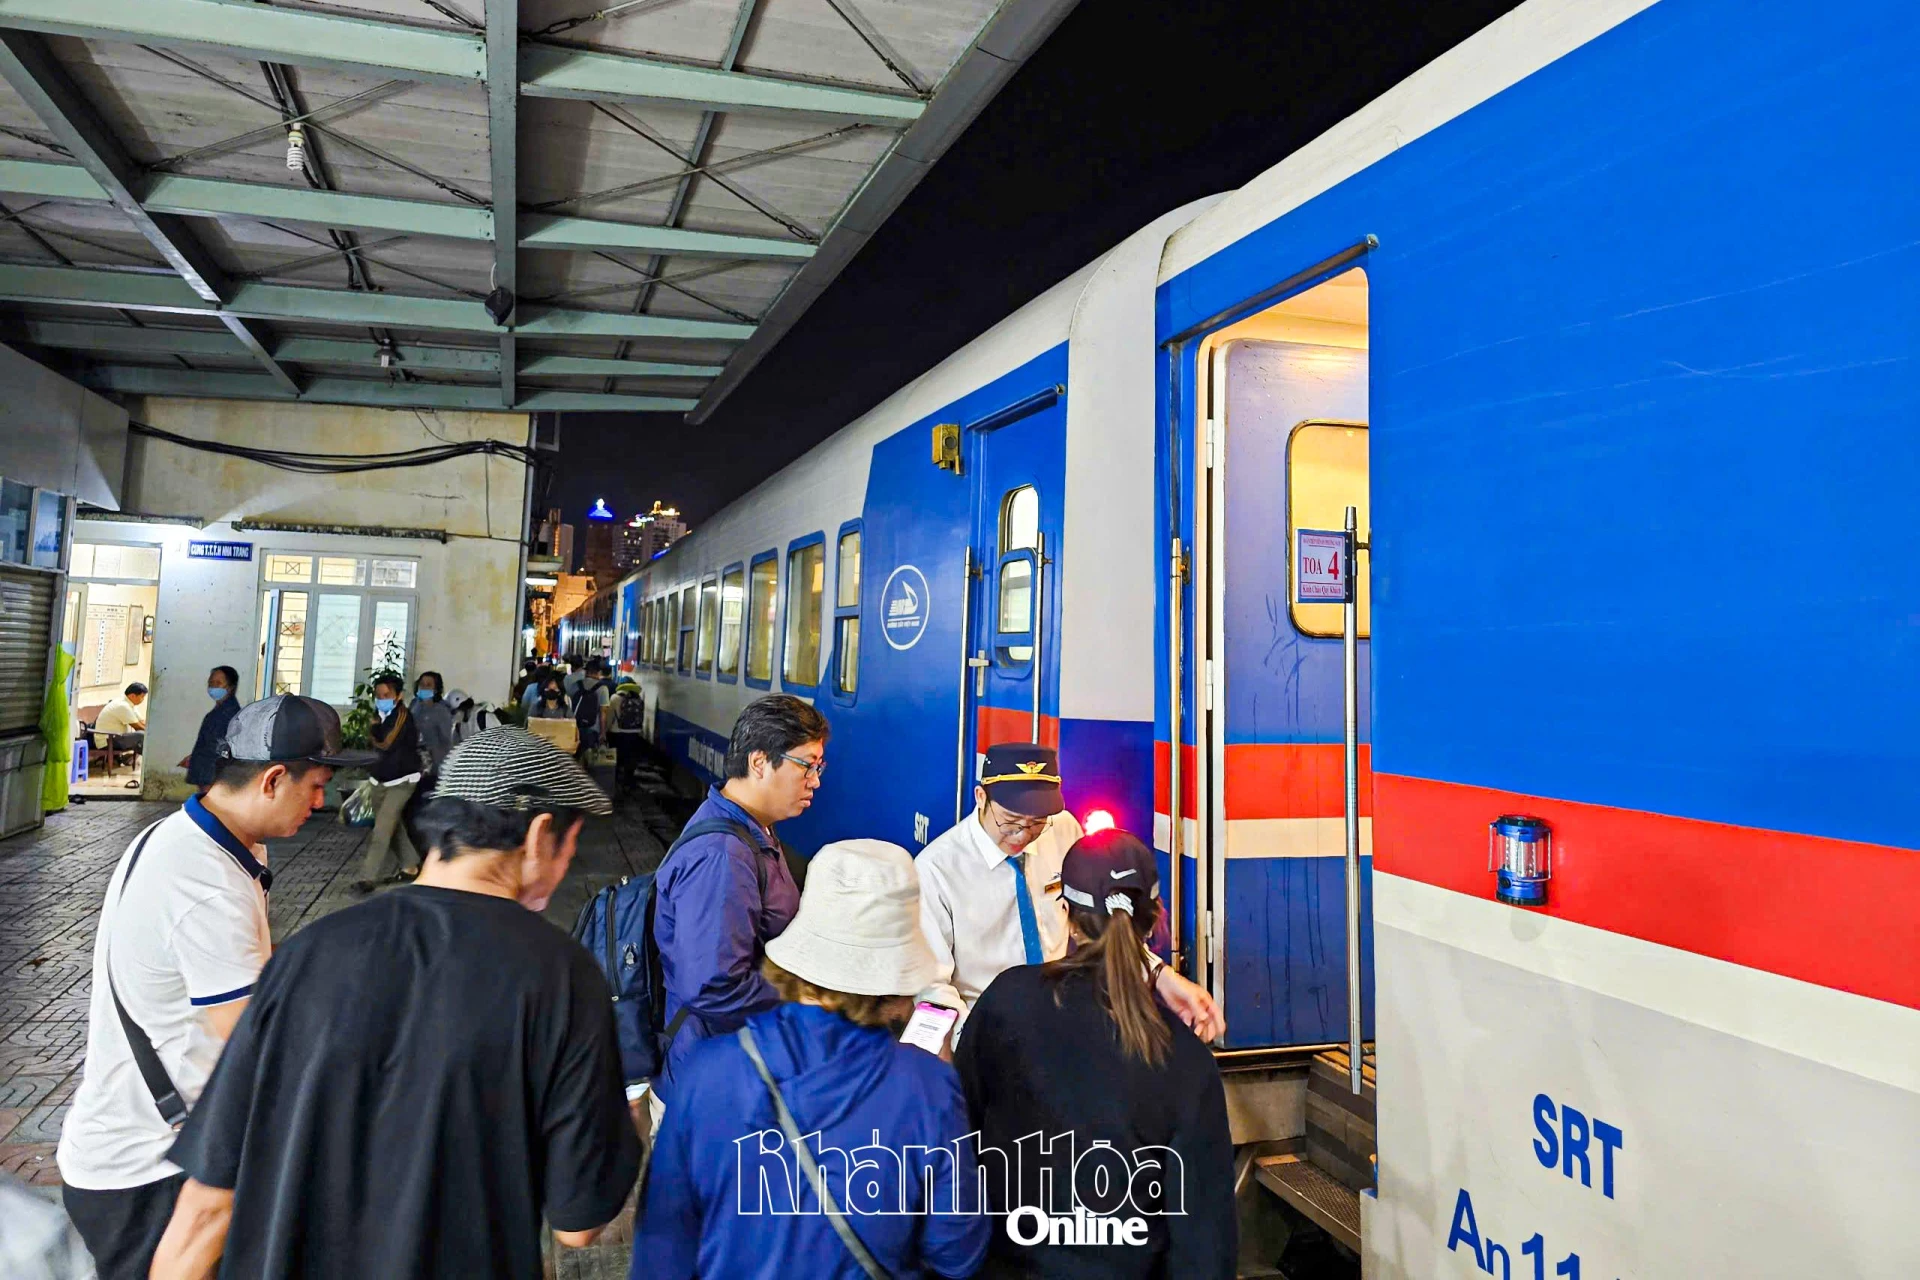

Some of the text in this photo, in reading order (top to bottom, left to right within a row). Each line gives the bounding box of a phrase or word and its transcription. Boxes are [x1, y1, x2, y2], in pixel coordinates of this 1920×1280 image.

[233, 546, 249, 558] TRANG
[1303, 551, 1339, 580] TOA 4
[914, 811, 929, 846] SRT
[1532, 1093, 1622, 1200] SRT
